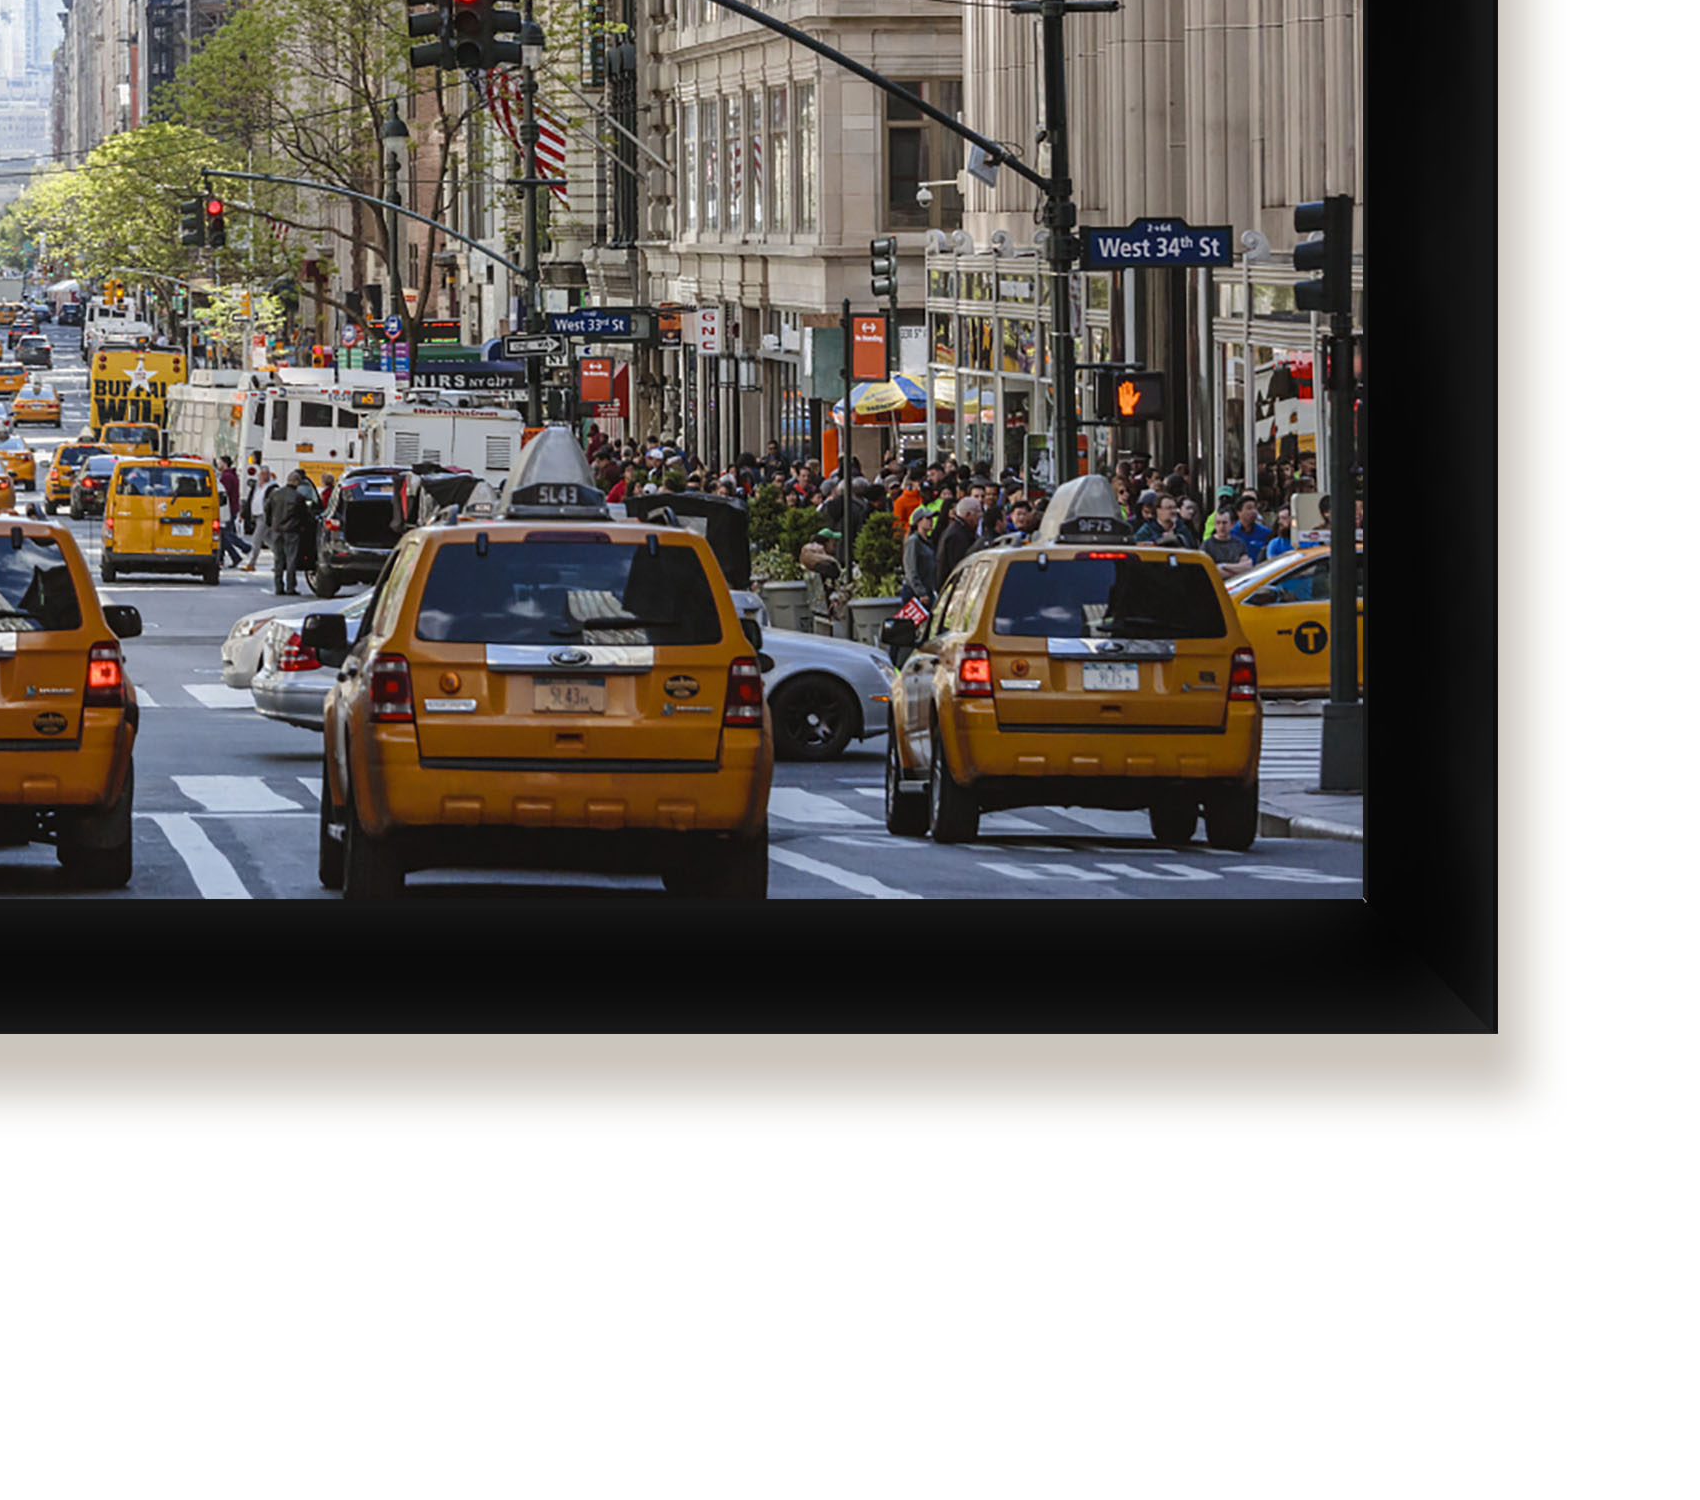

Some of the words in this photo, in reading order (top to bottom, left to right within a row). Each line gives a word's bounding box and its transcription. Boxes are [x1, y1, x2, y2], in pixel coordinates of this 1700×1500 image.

[1098, 238, 1151, 258] West
[1156, 235, 1194, 258] 34th
[1199, 237, 1221, 258] St
[554, 318, 586, 332] West
[587, 317, 610, 332] 33rd
[611, 318, 625, 332] St
[701, 311, 716, 351] GNC
[94, 379, 167, 399] BUFFAL
[468, 377, 485, 388] NY
[1301, 626, 1321, 651] T
